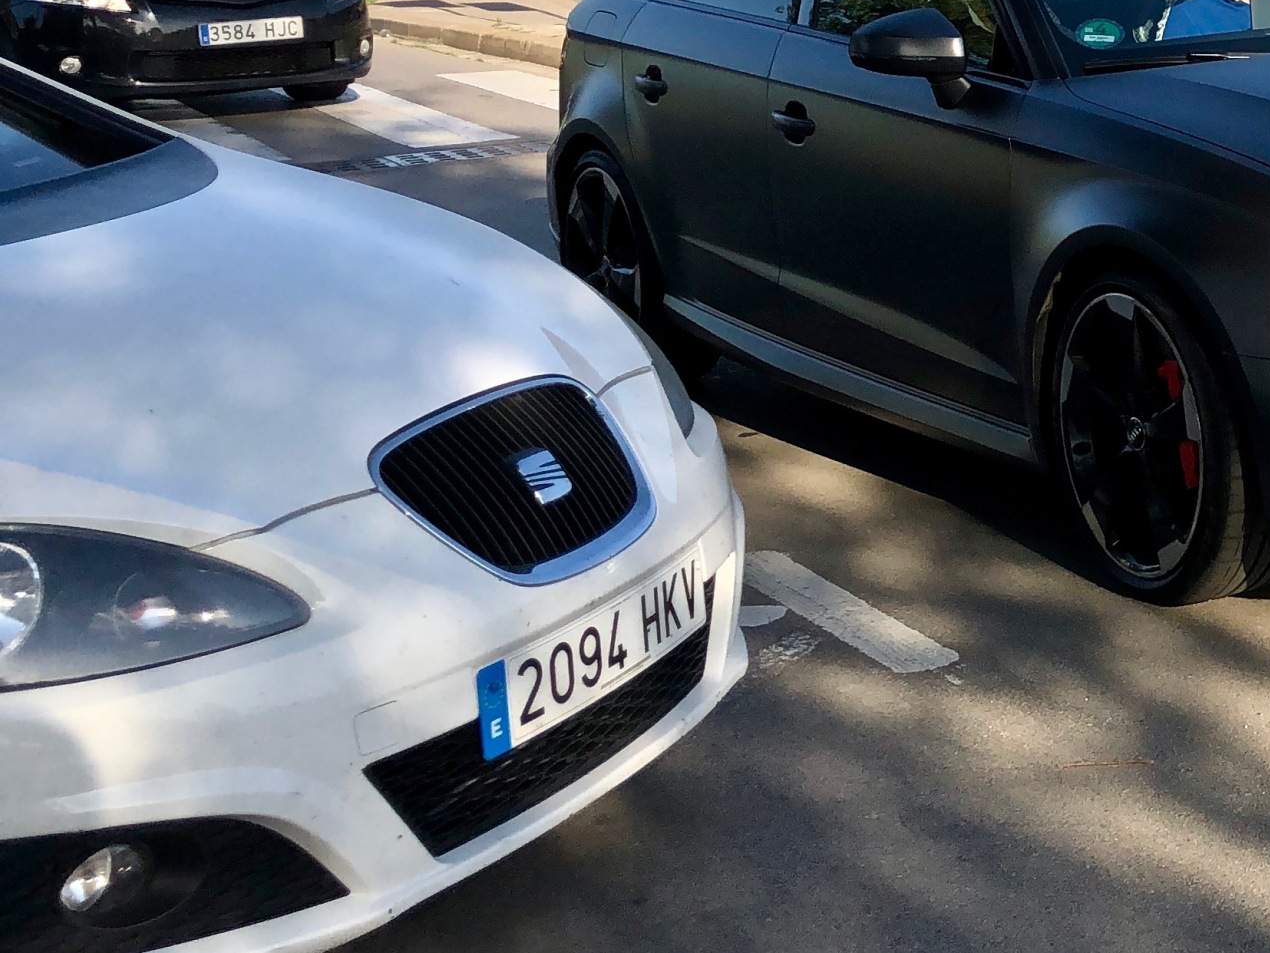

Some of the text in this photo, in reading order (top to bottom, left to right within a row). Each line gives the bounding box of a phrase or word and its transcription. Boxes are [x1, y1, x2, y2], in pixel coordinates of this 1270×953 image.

[210, 23, 256, 42] 3584
[264, 20, 298, 38] HJC
[490, 559, 696, 739] E 2094 HKV
